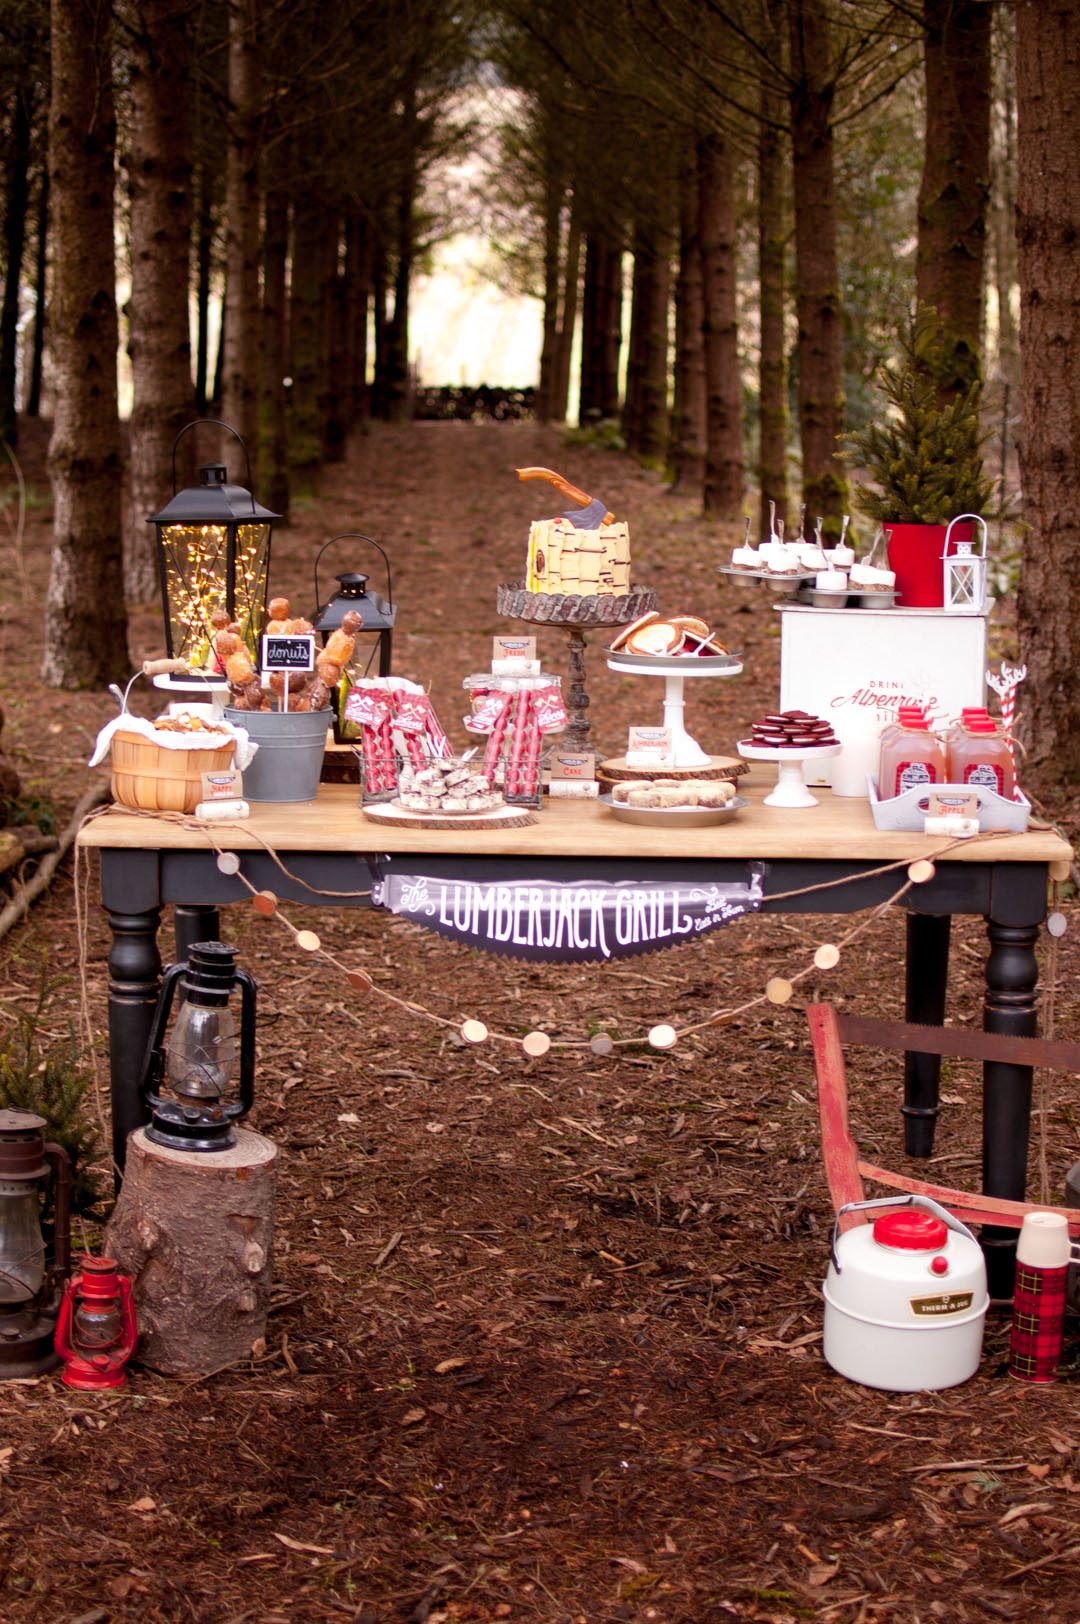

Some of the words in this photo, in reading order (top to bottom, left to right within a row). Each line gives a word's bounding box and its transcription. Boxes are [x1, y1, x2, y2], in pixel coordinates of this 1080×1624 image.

[268, 643, 309, 660] donuts
[400, 877, 430, 905] The
[439, 885, 611, 958] LUMBERJACK
[615, 888, 693, 946] GRILL
